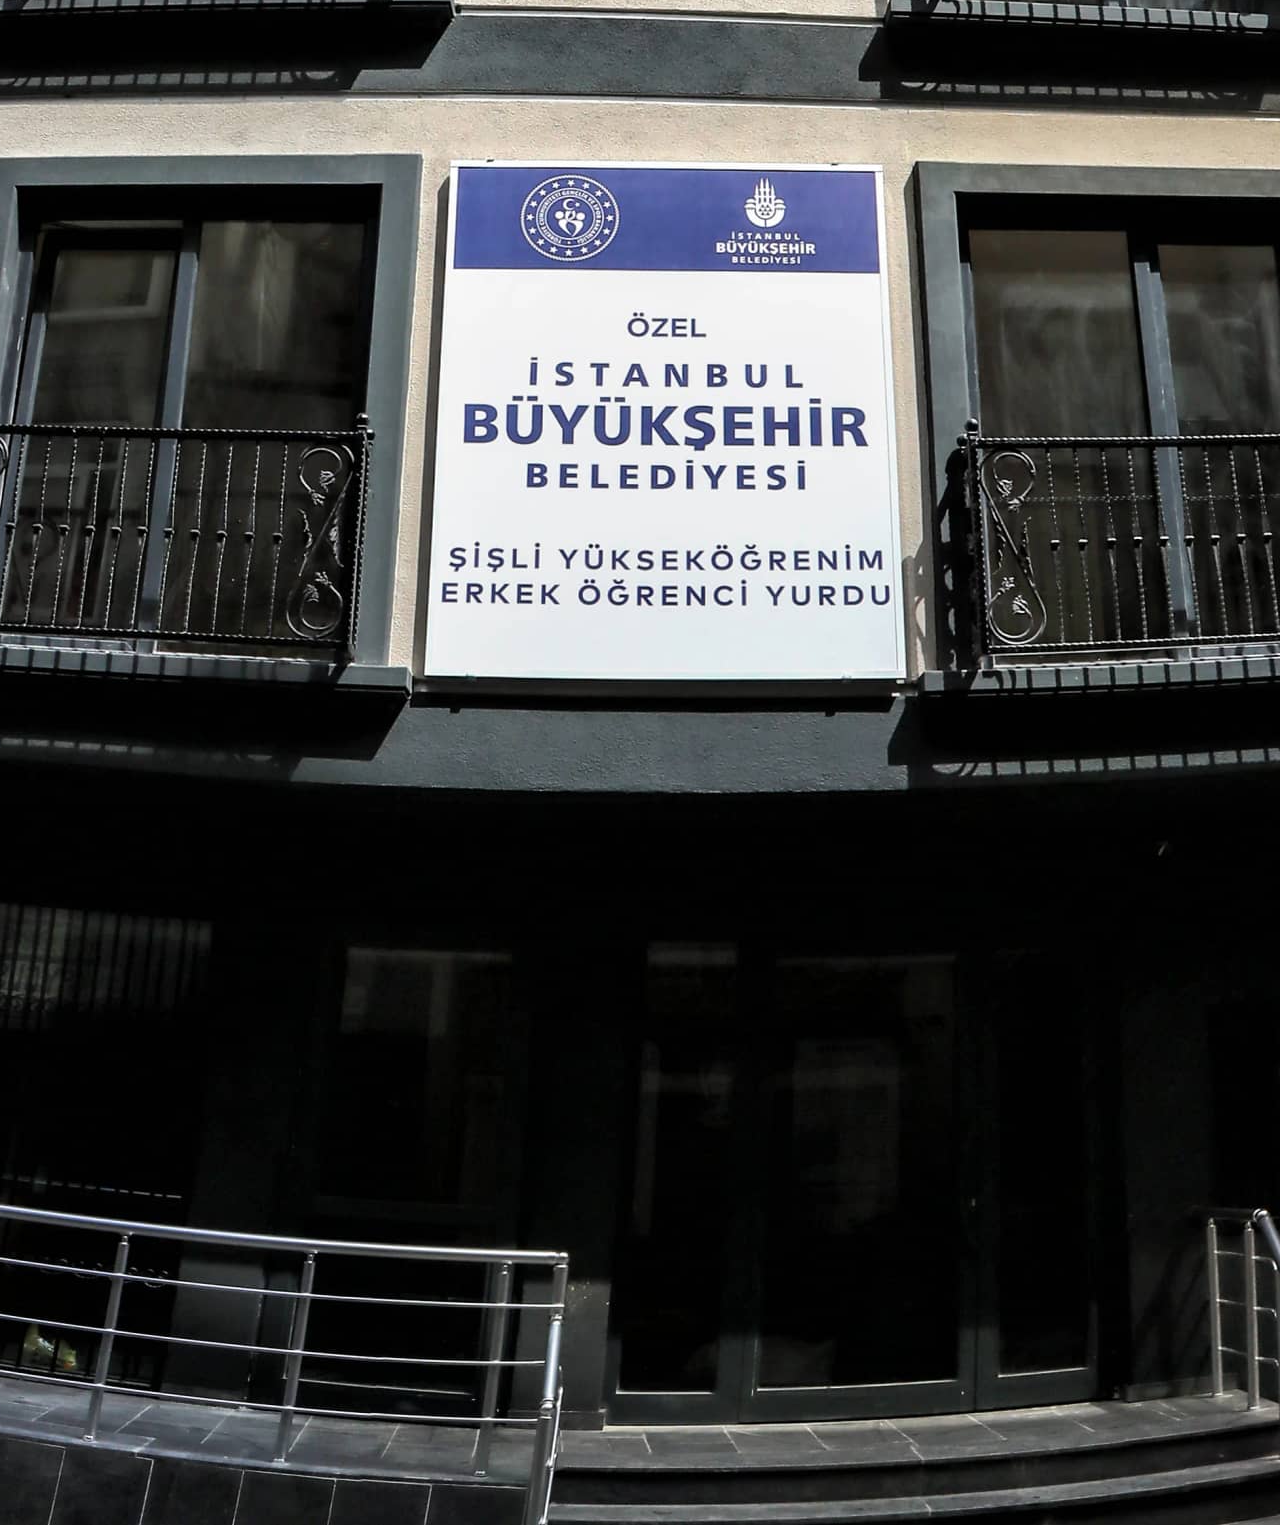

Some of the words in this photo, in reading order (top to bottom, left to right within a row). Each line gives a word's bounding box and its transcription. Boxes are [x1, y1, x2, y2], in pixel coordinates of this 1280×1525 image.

[715, 240, 816, 255] BÜYÜKŞEHİR
[731, 231, 801, 240] İSTANBUL
[731, 255, 801, 264] BELEDİYESİ
[627, 312, 707, 338] ÖZEL
[529, 356, 804, 389] İSTANBUL
[463, 395, 869, 452] BÜYÜKŞEHİR
[526, 459, 806, 491] BELEDİYESİ
[448, 541, 541, 573] ŞİŞLİ
[558, 543, 883, 572] YÜKSEKÖĞRENİM
[440, 582, 561, 605] ERKEK
[577, 578, 748, 606] ÖĞRENCİ
[766, 584, 891, 607] YURDU
